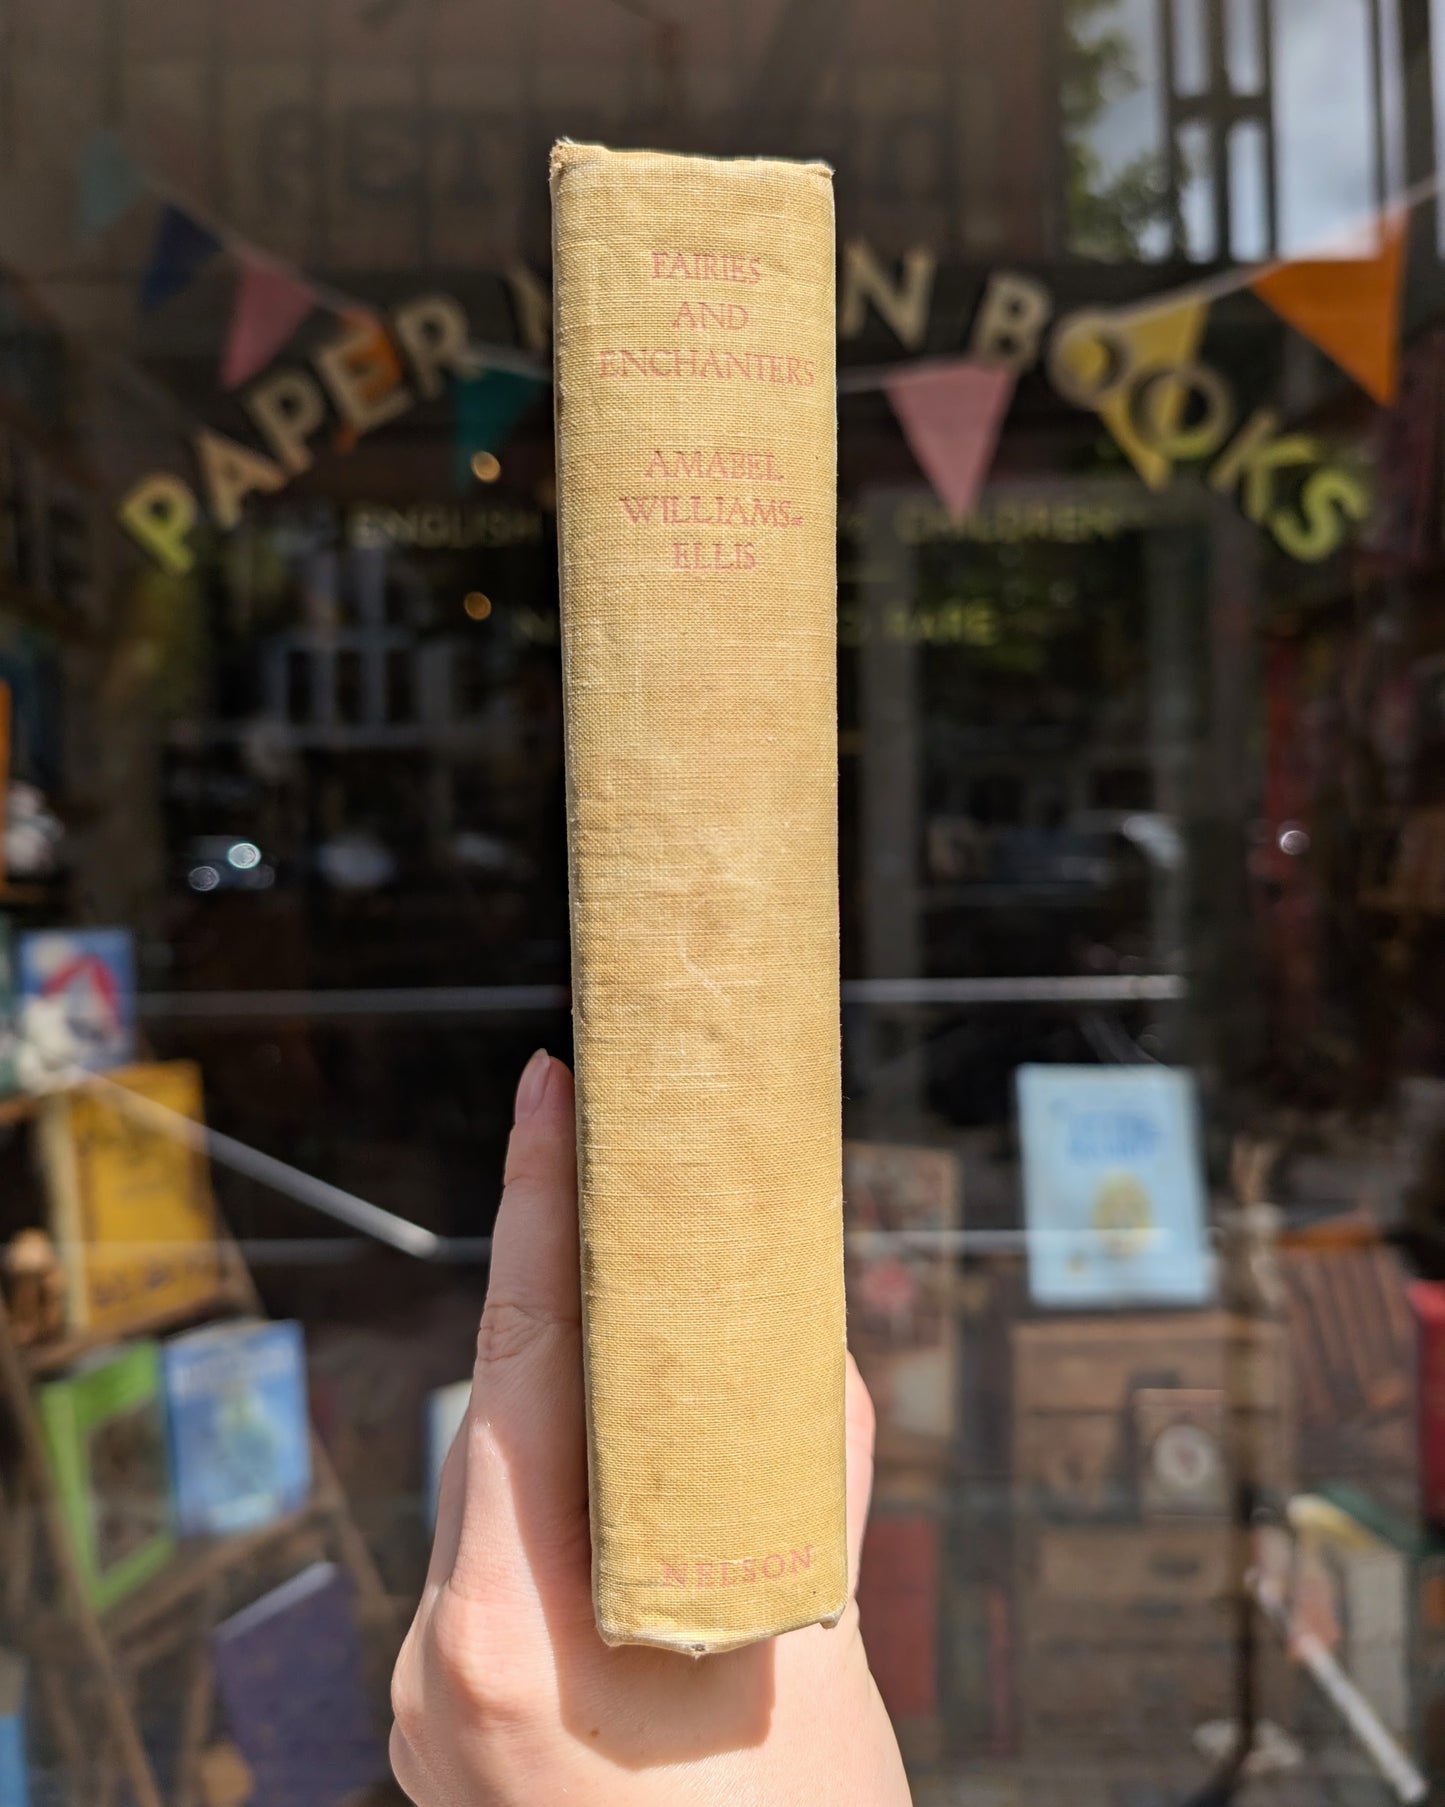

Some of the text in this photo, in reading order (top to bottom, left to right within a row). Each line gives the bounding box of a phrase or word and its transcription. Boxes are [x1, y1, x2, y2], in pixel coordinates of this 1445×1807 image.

[651, 250, 763, 285] FAIRIES
[671, 301, 750, 331] AND
[599, 349, 817, 388] ENCHANTERS
[116, 270, 1372, 577] PAPER BOOKS
[644, 450, 784, 483] AMABEL
[672, 542, 757, 572] ELLIS
[660, 1545, 815, 1589] NELSON
